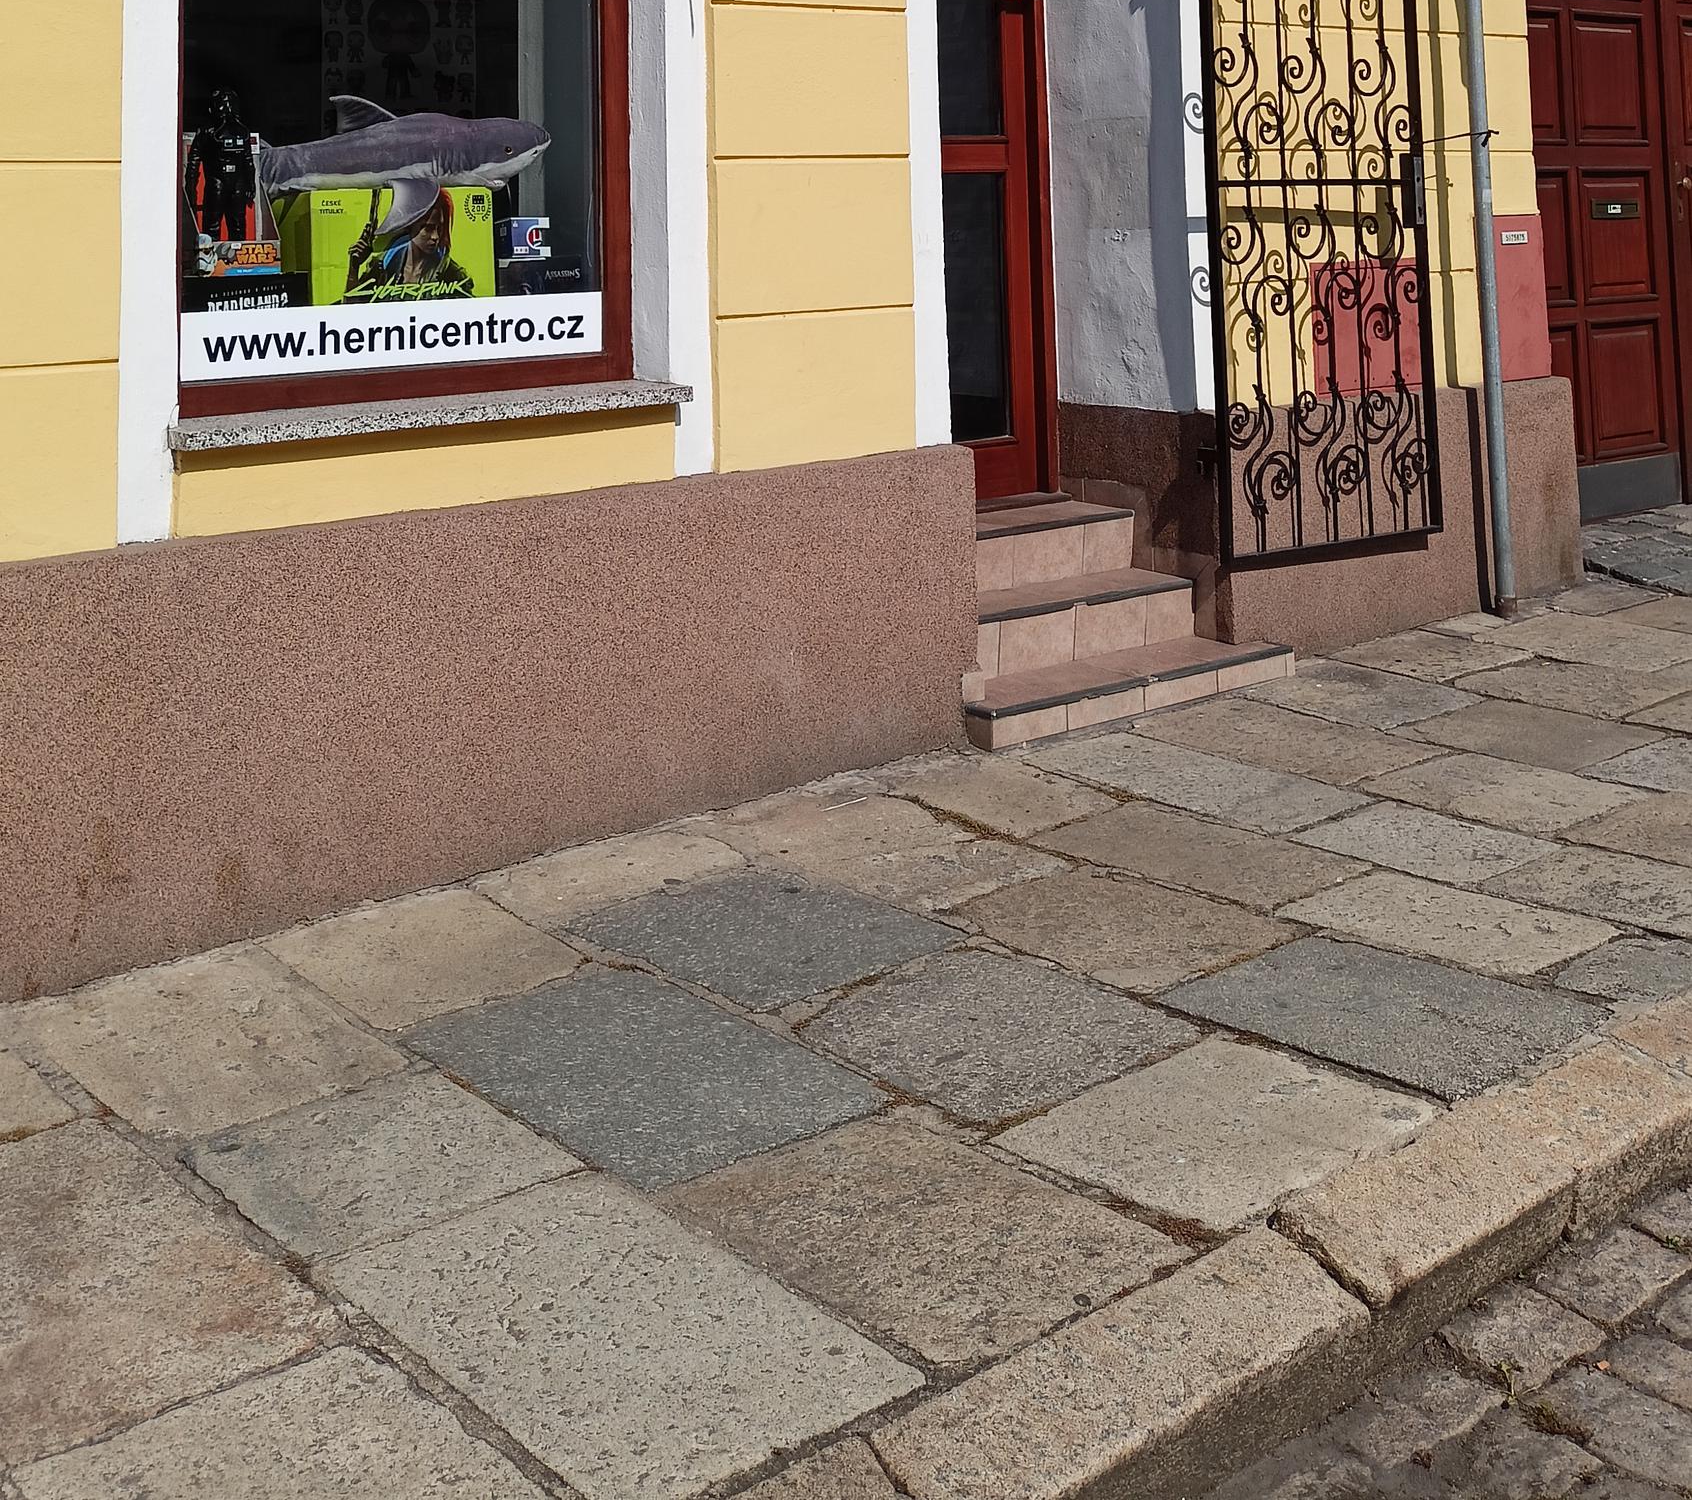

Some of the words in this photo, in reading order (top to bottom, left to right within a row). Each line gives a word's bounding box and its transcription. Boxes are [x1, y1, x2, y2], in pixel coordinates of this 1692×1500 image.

[237, 244, 276, 254] STAR
[236, 253, 276, 264] WARS
[202, 313, 585, 363] www.hernicentro.cz
